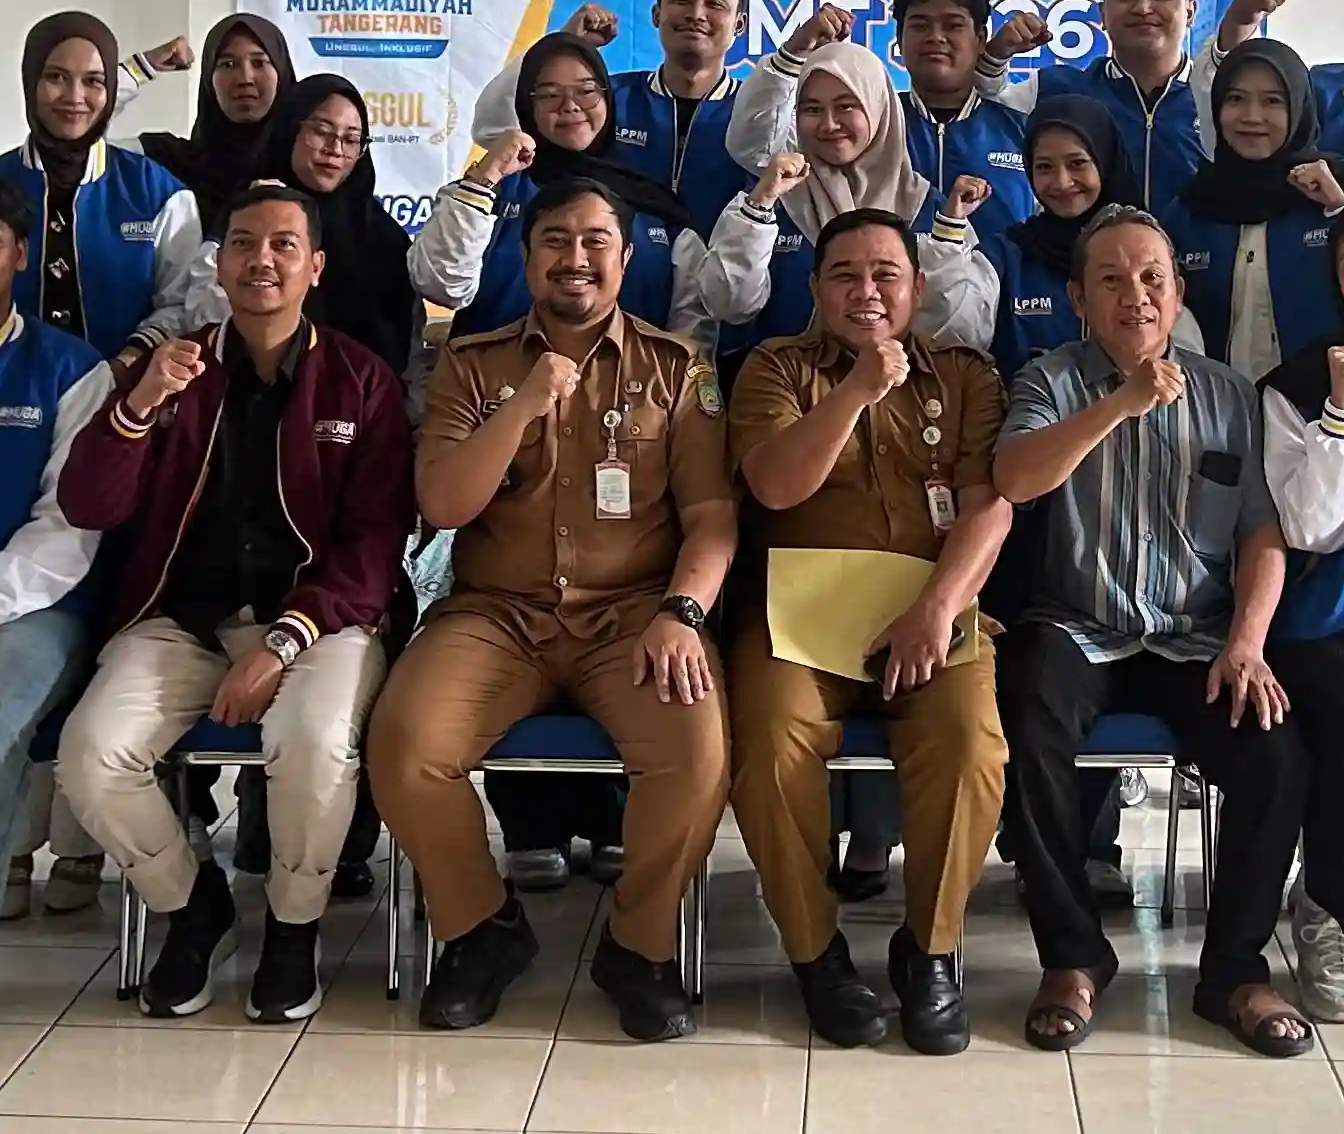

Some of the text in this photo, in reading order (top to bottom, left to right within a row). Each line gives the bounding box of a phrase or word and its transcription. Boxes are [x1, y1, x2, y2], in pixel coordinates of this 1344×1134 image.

[317, 14, 443, 35] TANGERANG
[363, 90, 431, 127] GGUL
[616, 126, 648, 143] LPPM
[1014, 297, 1051, 310] LPPM
